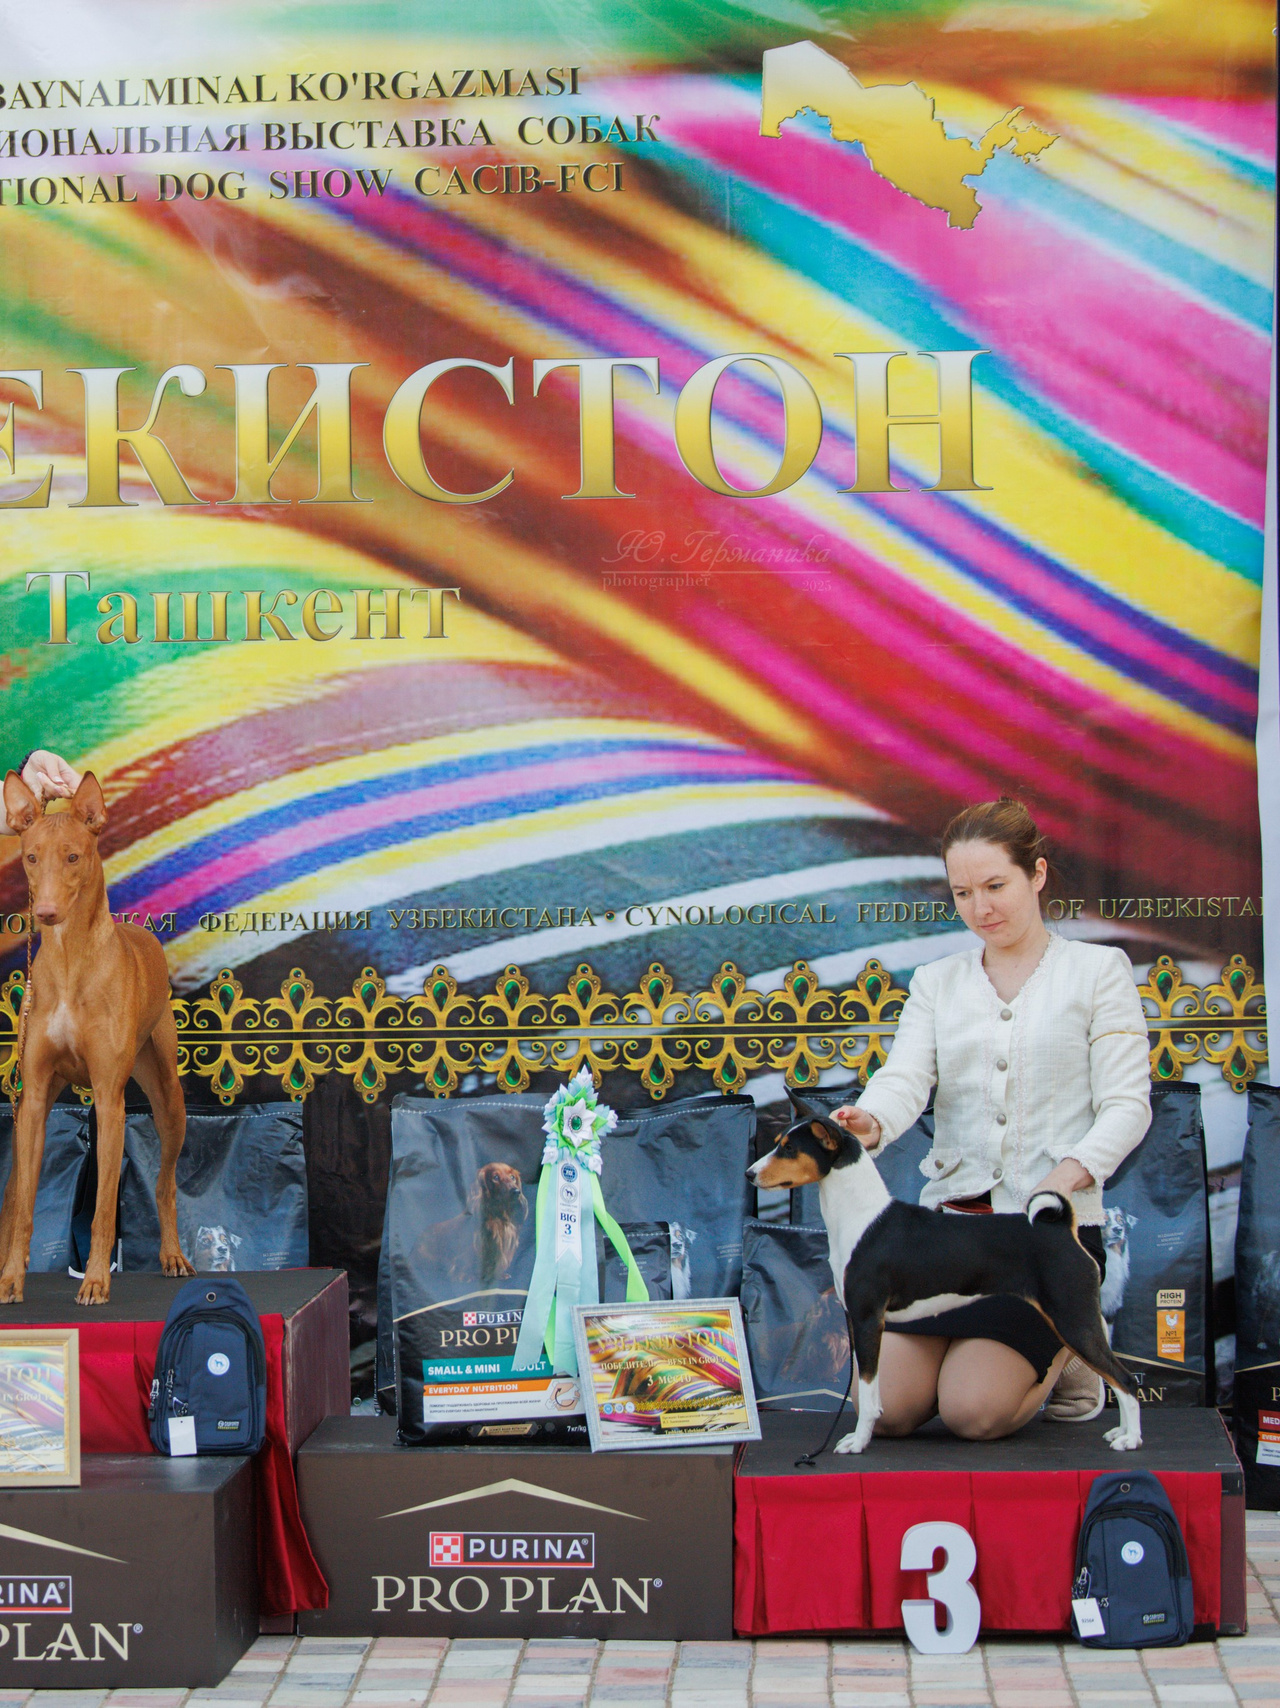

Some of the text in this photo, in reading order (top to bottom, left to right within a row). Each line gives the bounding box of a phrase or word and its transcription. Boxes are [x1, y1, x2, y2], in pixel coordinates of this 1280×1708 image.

[287, 66, 581, 102] KO'RGAZMASI
[261, 117, 496, 151] ВЫСТАВКА
[517, 113, 662, 146] СОБАК
[156, 171, 248, 203] DOG
[269, 168, 394, 200] SHOW
[414, 162, 626, 196] CACIB-FCI
[25, 571, 461, 645] Ташкент
[198, 911, 373, 935] ФЕДЕРАЦИЯ
[387, 906, 597, 930] УЗБЕКИСТАНА
[625, 902, 836, 926] CYNOLOGICAL
[856, 901, 963, 923] FEDER
[1047, 899, 1084, 920] OF
[560, 1212, 577, 1223] BIG
[564, 1223, 572, 1235] 3
[478, 1312, 522, 1324] PURIN
[440, 1328, 490, 1348] PRO
[428, 1365, 463, 1376] SMALL
[465, 1365, 472, 1374] &
[475, 1363, 500, 1374] MINI
[667, 1357, 688, 1366] BEST
[689, 1356, 697, 1364] IN
[428, 1384, 518, 1394] EVERYDAY NUTRITION
[647, 1374, 692, 1387] 3 место
[1107, 1387, 1163, 1403] PAN
[371, 1575, 490, 1612] PRO
[900, 1520, 981, 1654] 3
